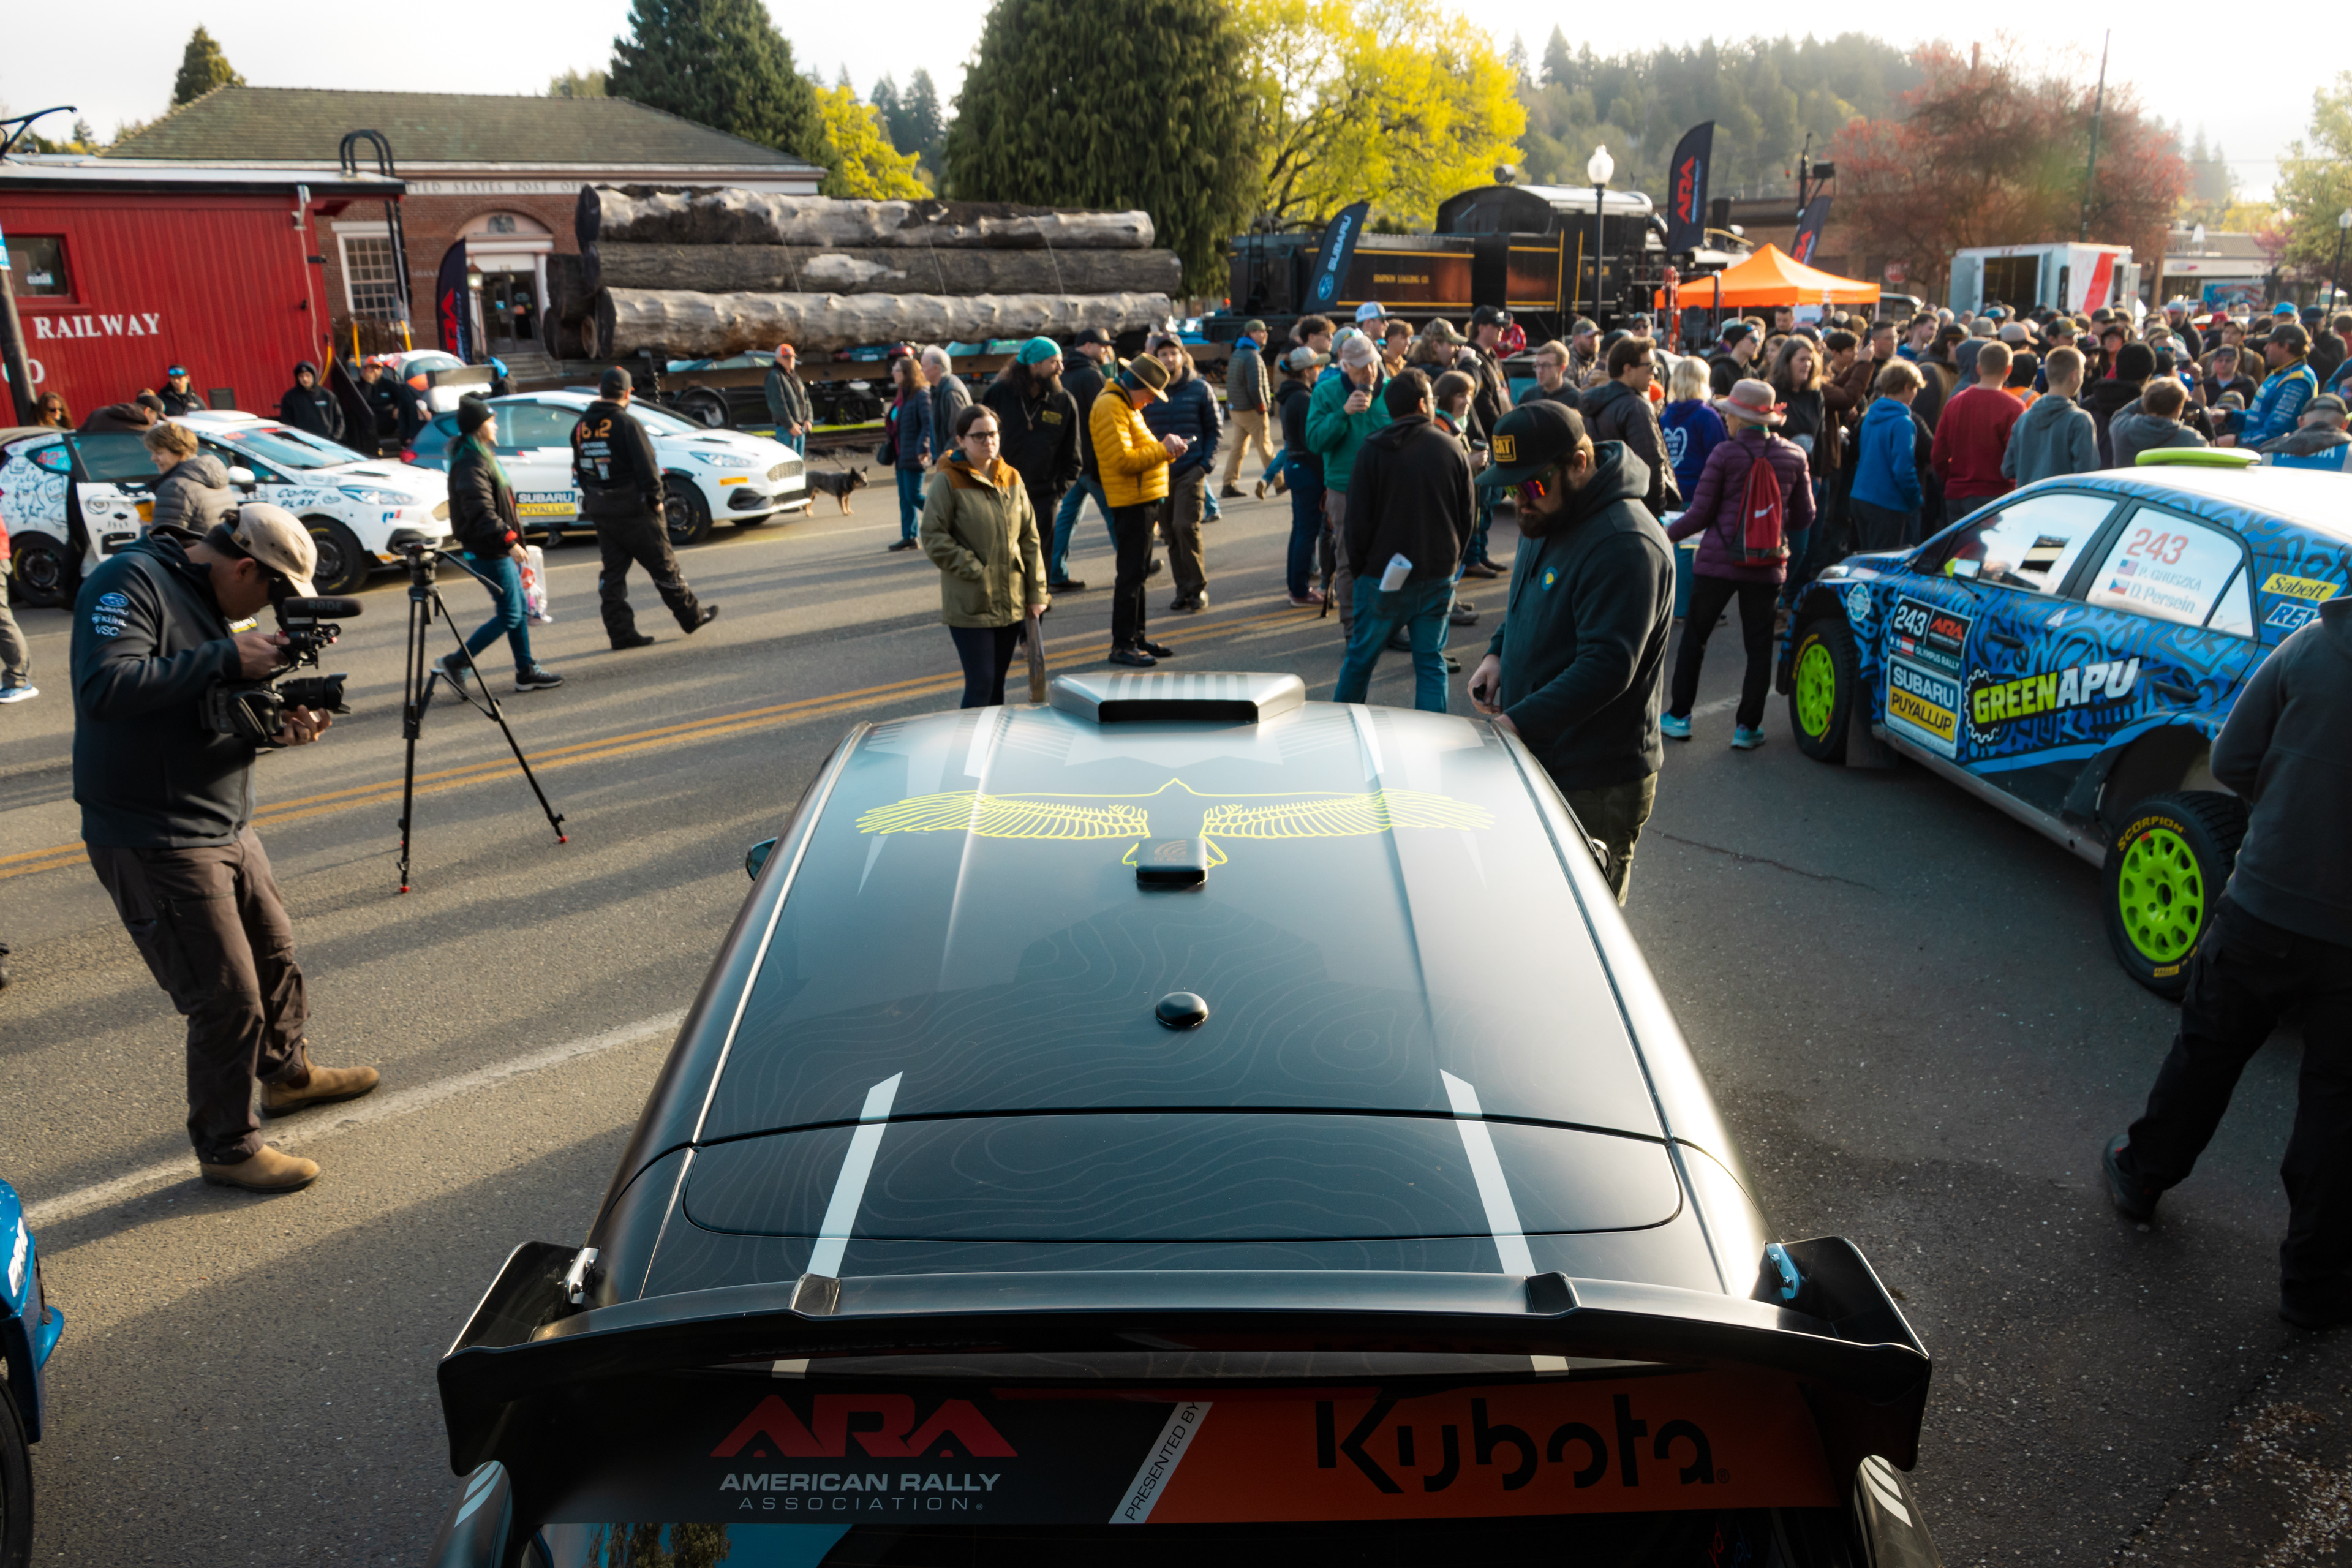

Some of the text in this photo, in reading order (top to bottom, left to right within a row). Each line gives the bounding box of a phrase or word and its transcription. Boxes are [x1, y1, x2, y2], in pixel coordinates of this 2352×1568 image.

[453, 181, 503, 192] STATES
[515, 181, 548, 192] POST
[1677, 156, 1695, 224] ARA
[1327, 215, 1352, 272] SUBARU
[33, 313, 159, 339] RAILWAY
[1494, 439, 1510, 454] CAT
[277, 488, 321, 497] COME
[518, 493, 573, 503] SUBARU
[2126, 528, 2188, 565] 243
[2150, 568, 2202, 592] GRUSZKA
[2270, 576, 2328, 598] Sabelt
[2129, 583, 2196, 613] D. Persein
[95, 625, 120, 636] VSC
[1894, 605, 1928, 637] 243
[1929, 617, 1964, 641] ARA
[1915, 646, 1960, 670] OLYMPUS RALLY
[1893, 666, 1954, 708] SUBARU
[1973, 657, 2140, 724] GREENAPU
[1891, 692, 1953, 731] PUYALLUP
[2117, 816, 2184, 851] SCORPION
[710, 1394, 1019, 1457] ARA
[1314, 1394, 1715, 1493] Kubota
[1125, 1402, 1199, 1521] PRESENTED BY
[719, 1473, 1001, 1491] AMERICAN RALLY
[739, 1498, 968, 1510] ASSOCIATION
